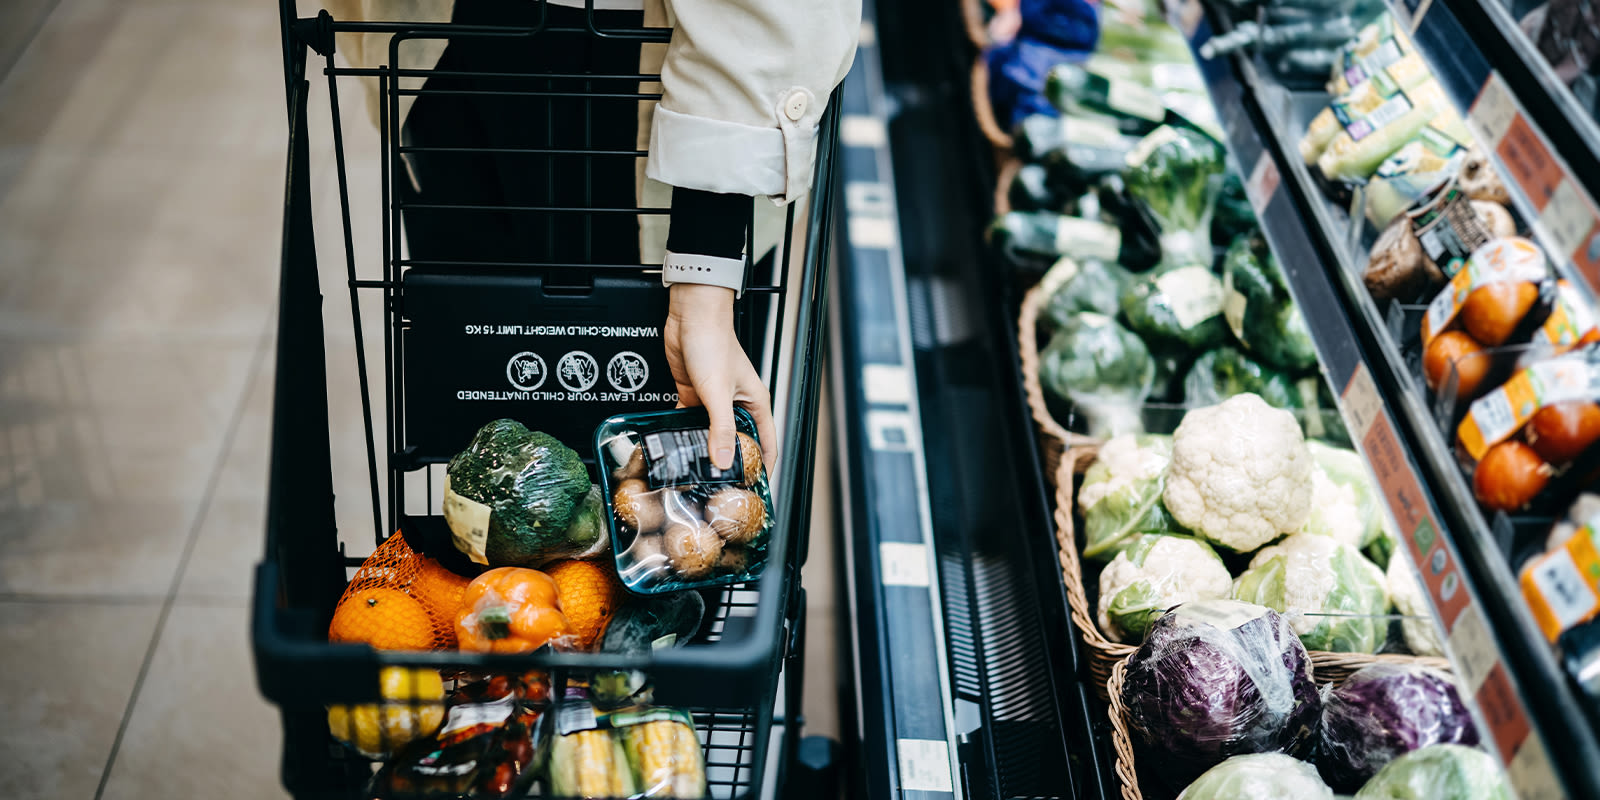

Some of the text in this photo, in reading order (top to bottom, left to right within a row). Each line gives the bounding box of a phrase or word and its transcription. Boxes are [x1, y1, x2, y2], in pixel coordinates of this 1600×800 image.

[465, 324, 481, 335] KG
[483, 324, 495, 335] 15
[496, 324, 523, 335] LIMIT
[524, 325, 567, 335] WEIGHT
[457, 390, 679, 402] DO NOT LEAVE YOUR CHILD UNATTENDED
